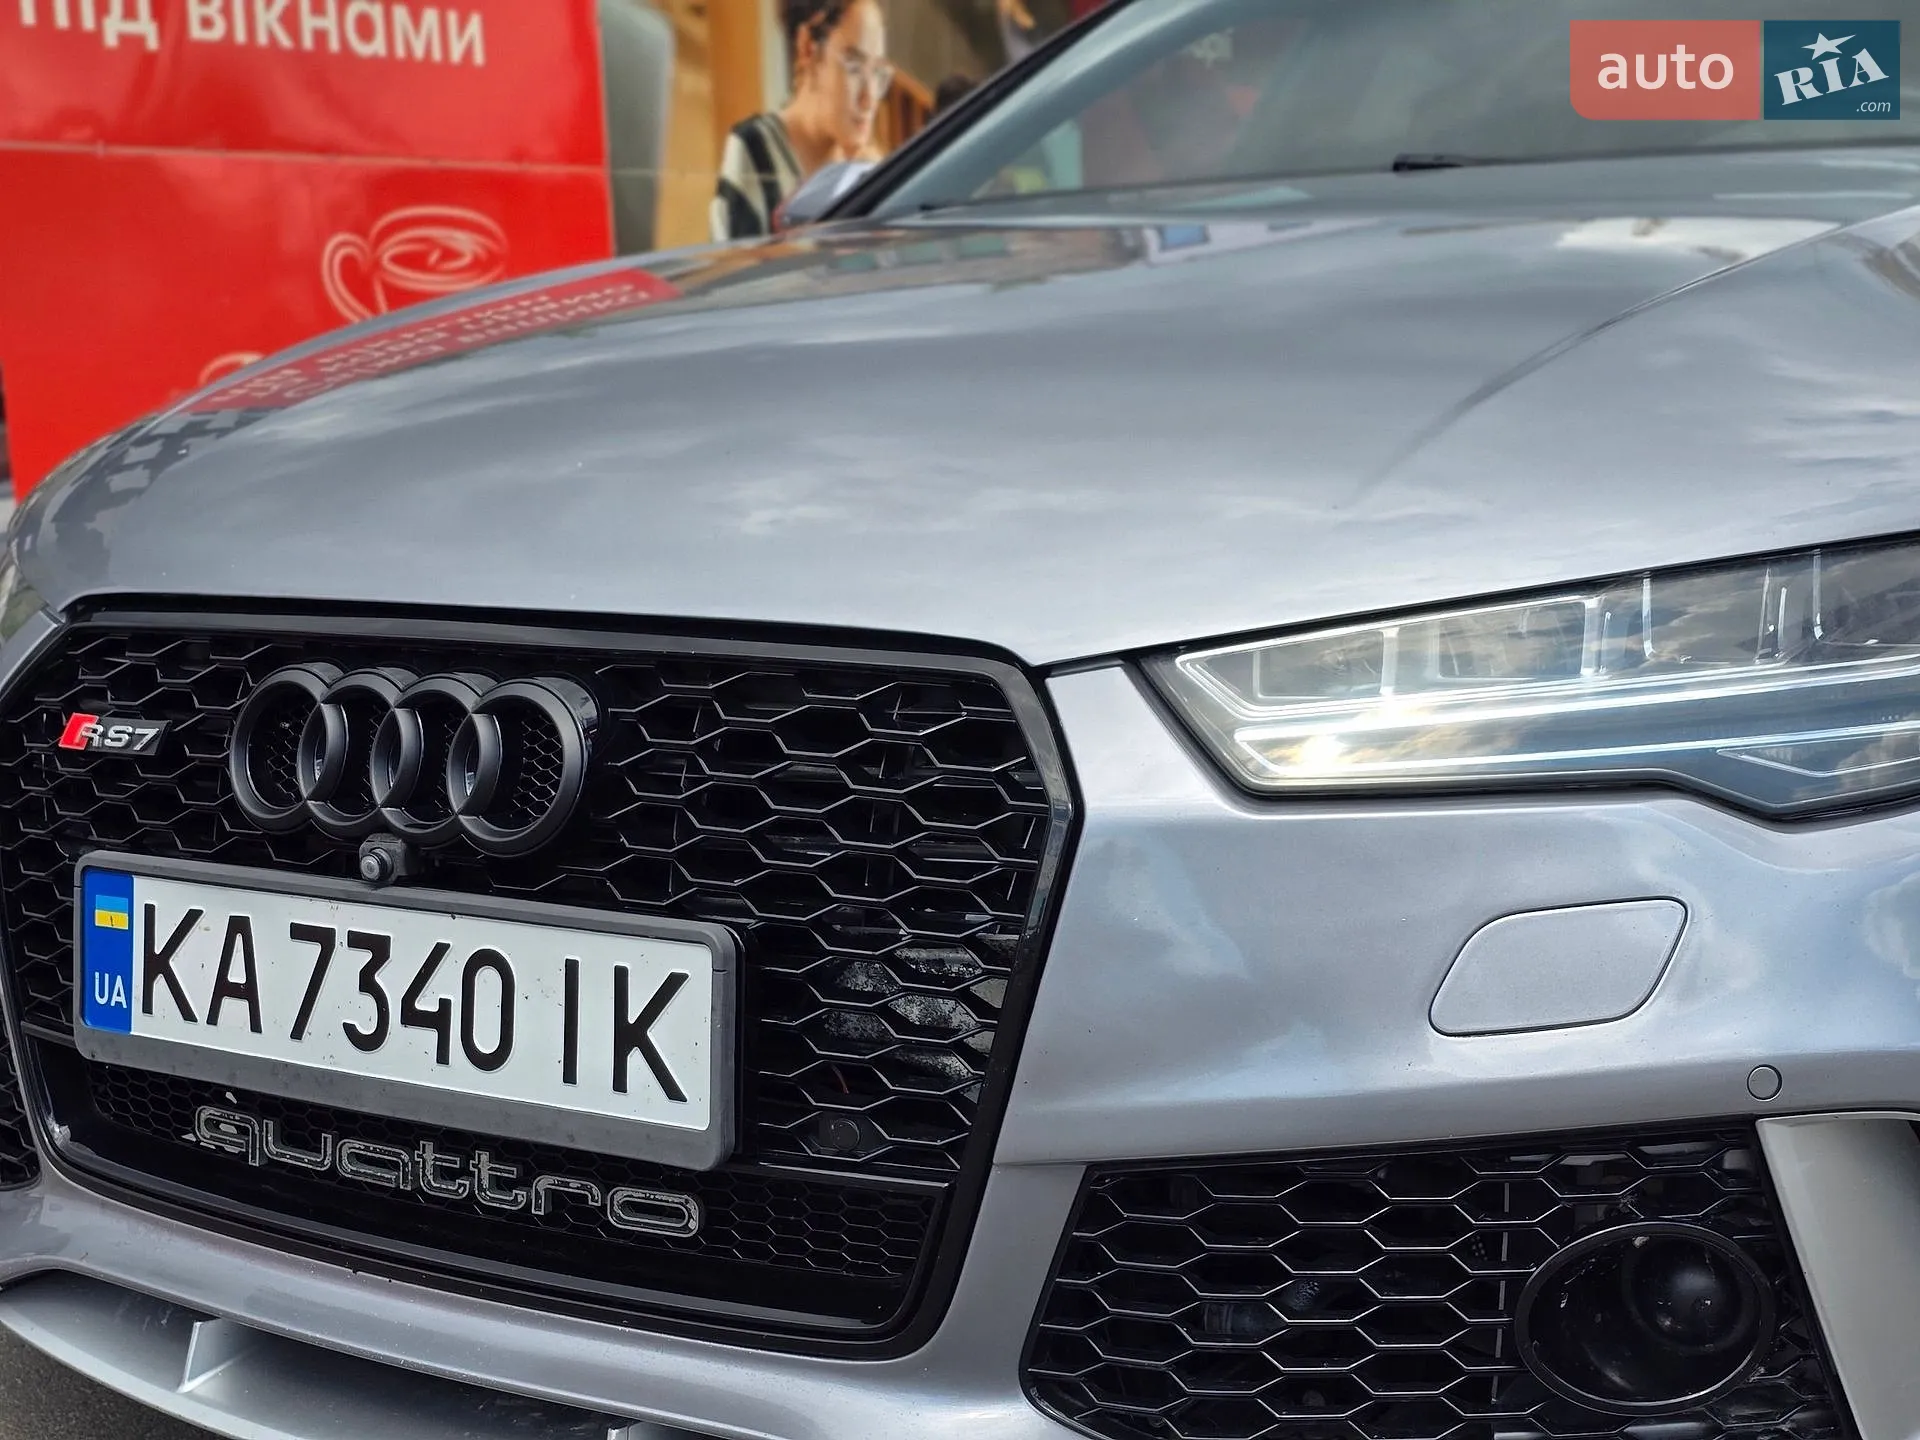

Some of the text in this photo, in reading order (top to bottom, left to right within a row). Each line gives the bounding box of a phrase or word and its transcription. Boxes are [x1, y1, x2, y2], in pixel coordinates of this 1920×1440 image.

[70, 716, 162, 753] RS7
[94, 971, 128, 1010] UA
[141, 902, 691, 1104] KA 7340 IK
[194, 1104, 701, 1238] quattro
